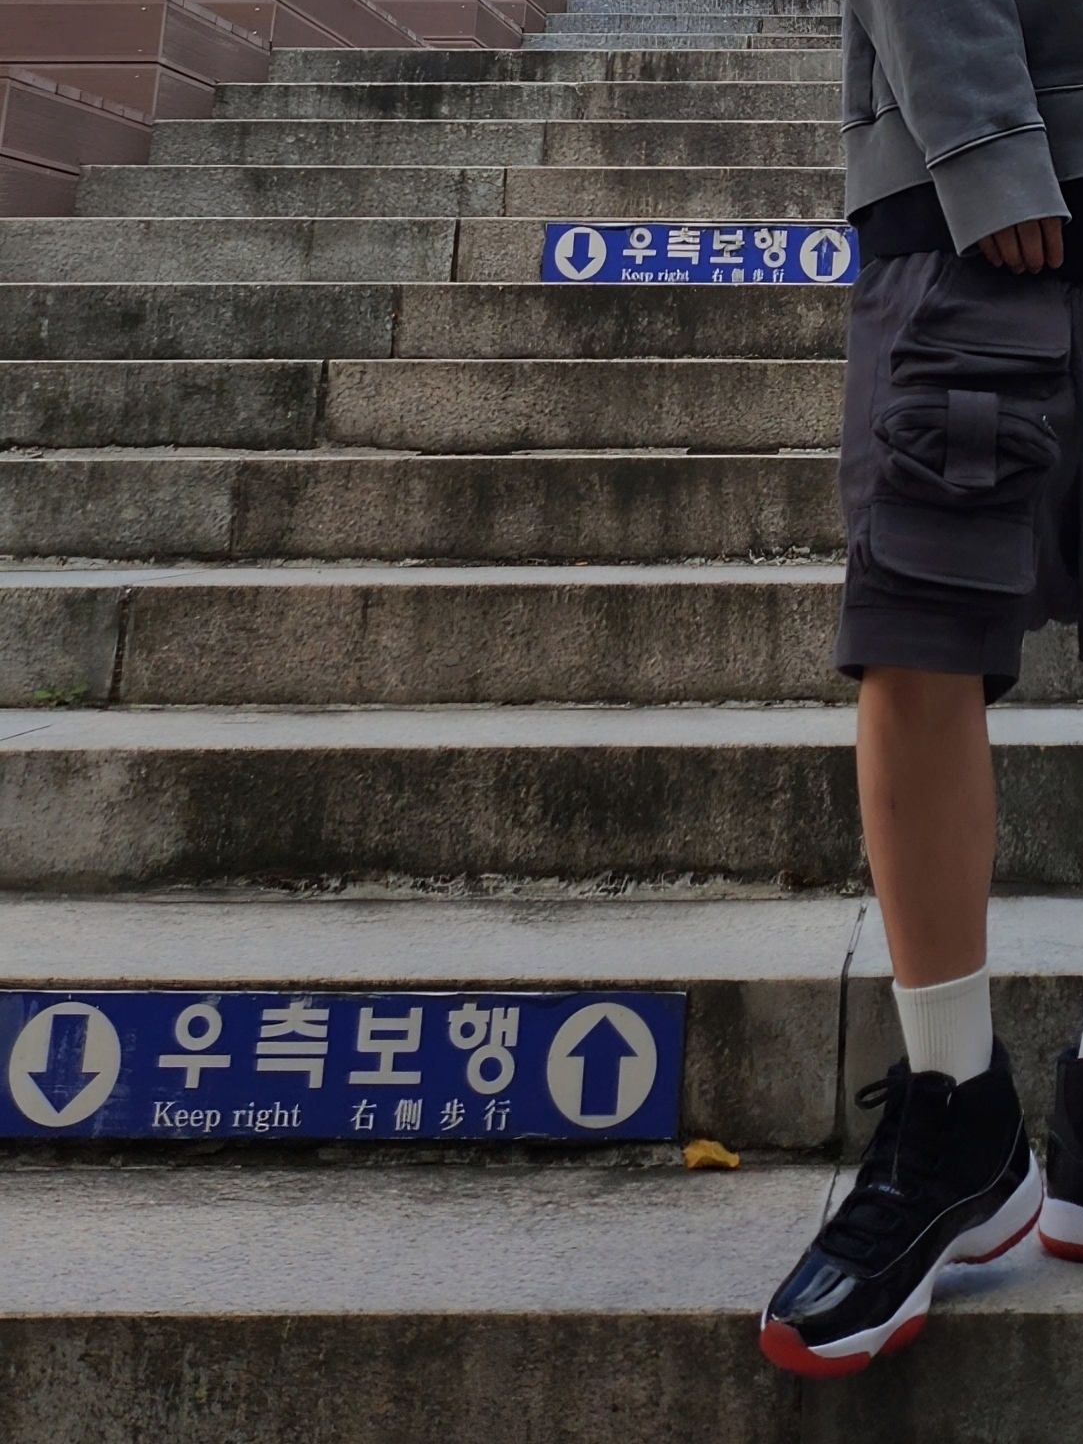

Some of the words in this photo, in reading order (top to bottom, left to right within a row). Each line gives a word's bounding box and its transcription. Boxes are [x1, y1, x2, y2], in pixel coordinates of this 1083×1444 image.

[623, 226, 788, 269] 우측보행
[158, 1002, 520, 1095] 우측보행
[151, 1101, 221, 1132] Keep
[232, 1102, 302, 1133] right
